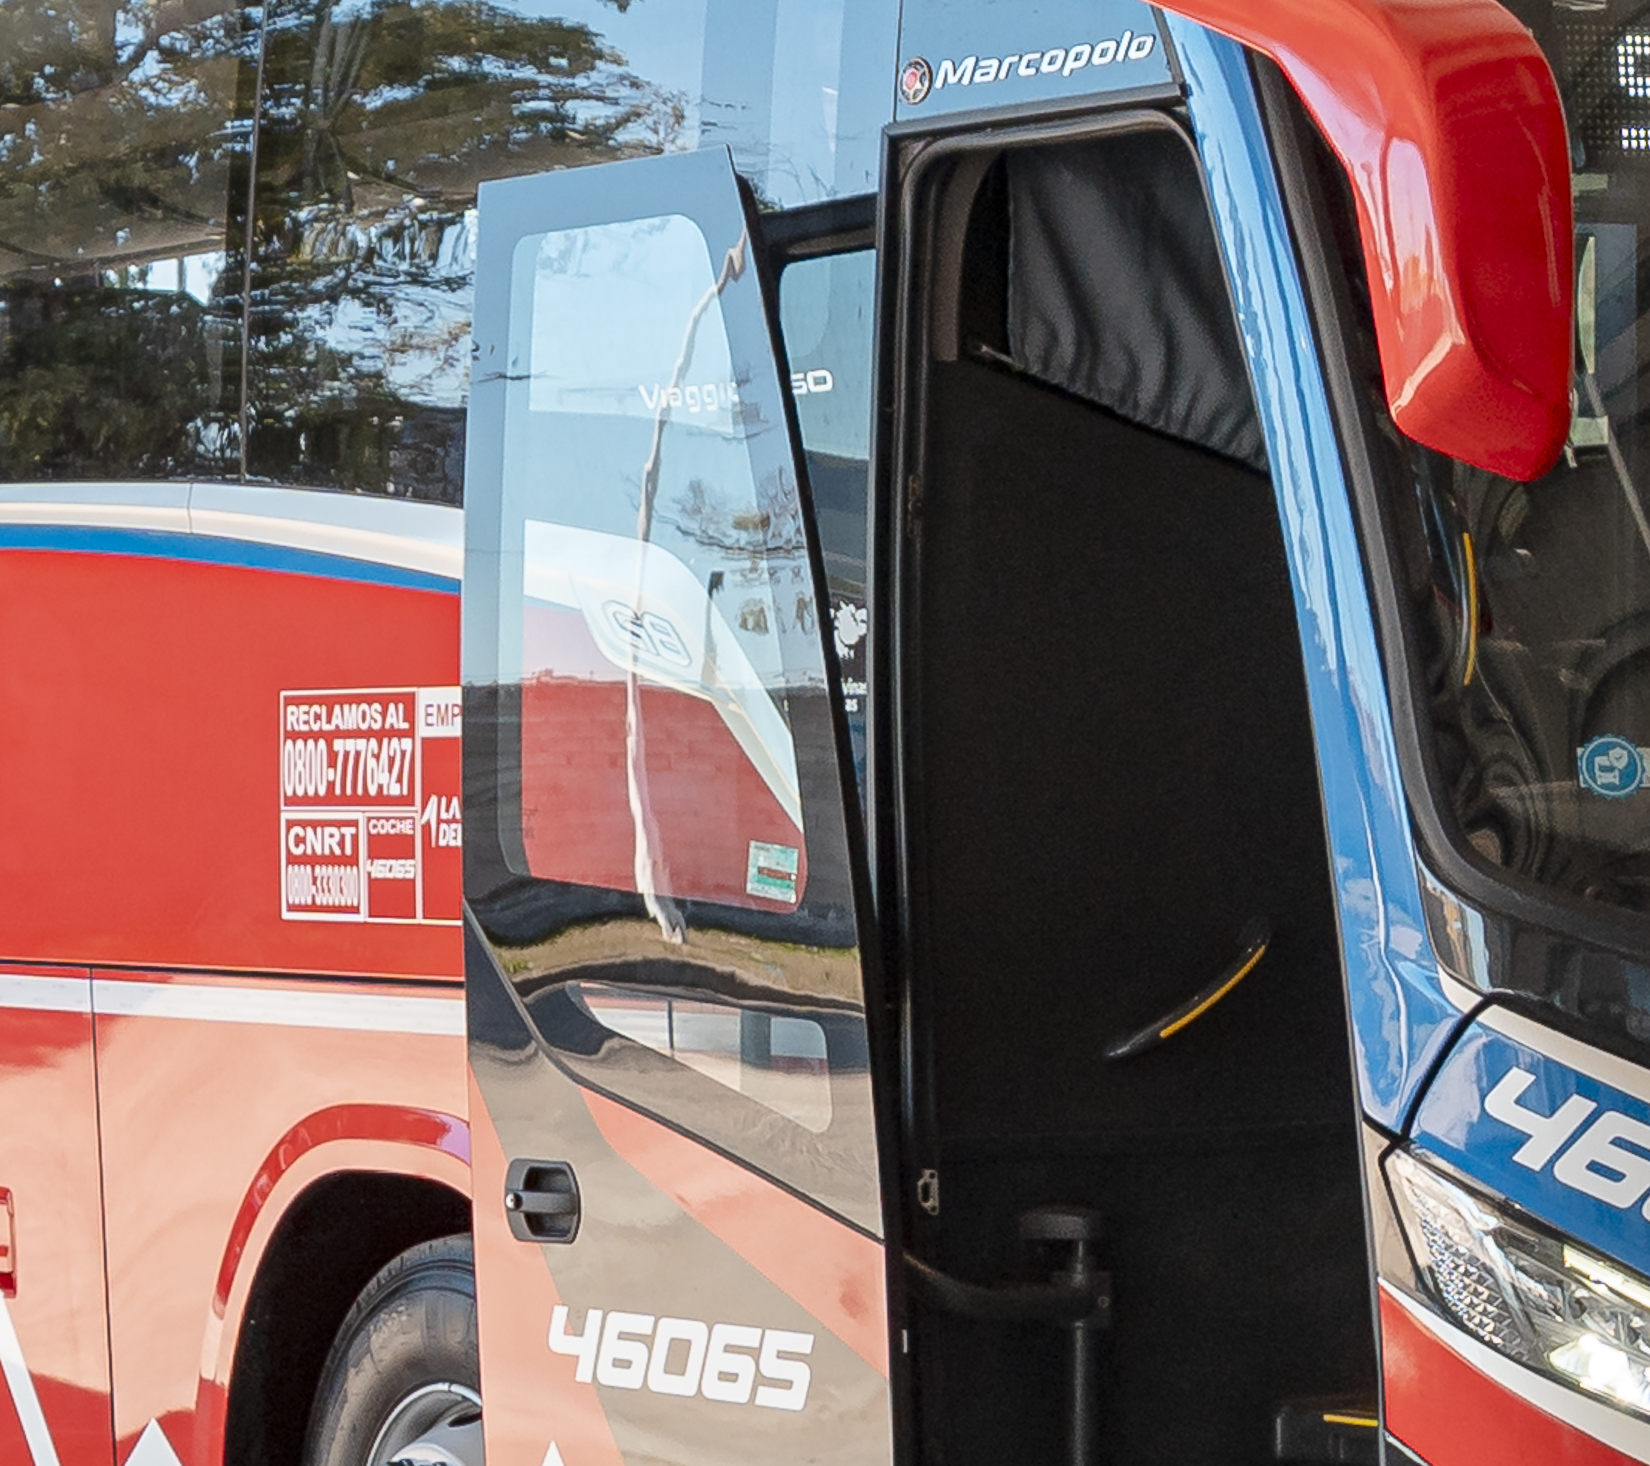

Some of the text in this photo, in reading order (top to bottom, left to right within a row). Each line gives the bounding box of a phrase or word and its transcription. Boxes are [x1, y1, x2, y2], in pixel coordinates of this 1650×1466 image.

[934, 30, 1156, 89] Marcopolo
[286, 701, 411, 732] RECLAMOS AL
[284, 736, 413, 798] 0800-7776427
[288, 826, 357, 856] CNRT
[368, 819, 414, 835] COCHE
[547, 1304, 816, 1412] 46065
